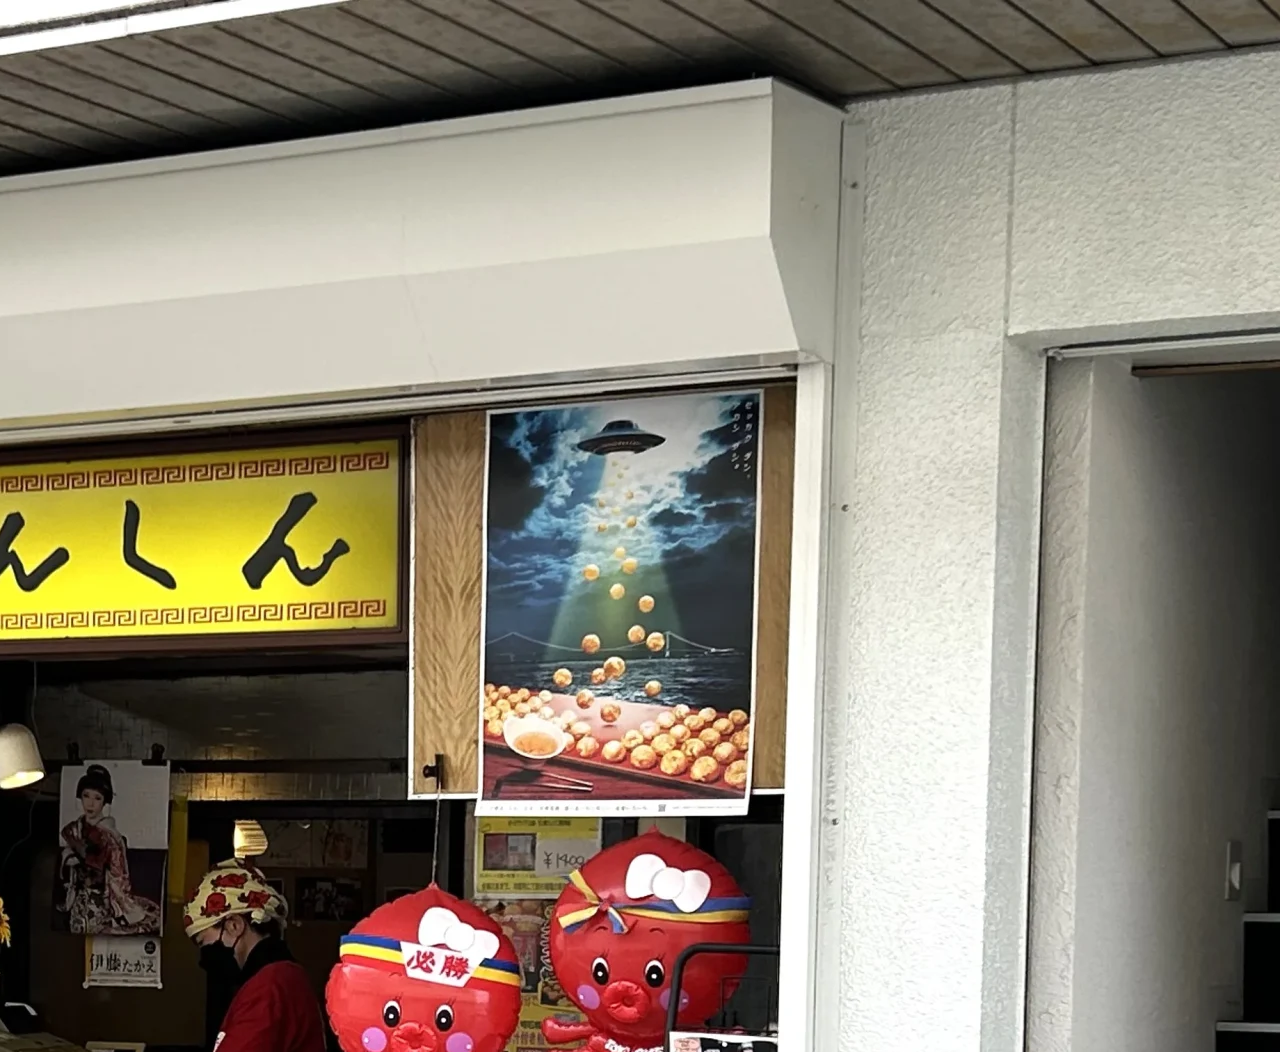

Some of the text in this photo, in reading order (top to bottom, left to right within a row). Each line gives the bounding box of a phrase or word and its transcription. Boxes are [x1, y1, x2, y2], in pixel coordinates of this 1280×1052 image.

[90, 953, 157, 973] 伊藤たかえ
[407, 950, 470, 980] 必勝
